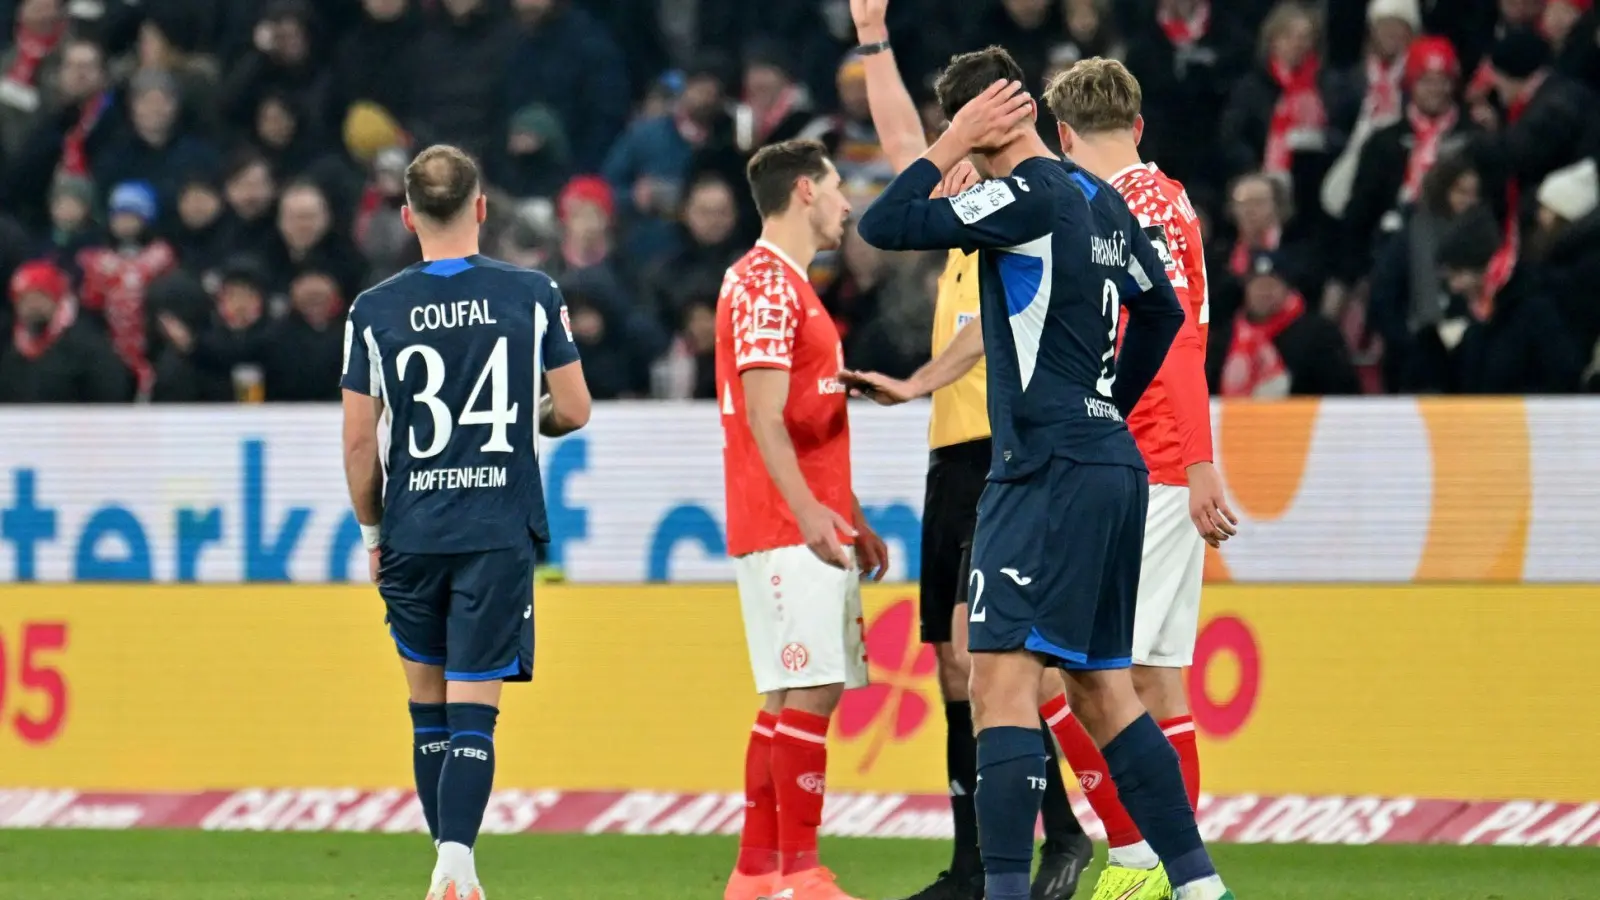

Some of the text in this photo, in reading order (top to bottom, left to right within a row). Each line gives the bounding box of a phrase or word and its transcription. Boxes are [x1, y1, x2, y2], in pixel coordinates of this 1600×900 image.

[1090, 230, 1126, 267] HRANÁČ
[410, 299, 497, 332] COUFAL
[1096, 278, 1119, 397] 2
[396, 336, 519, 459] 34
[408, 466, 507, 492] HOFFENHEIM
[969, 570, 986, 623] 2
[0, 621, 68, 743] 5
[420, 741, 450, 755] TSG
[452, 747, 488, 761] TSG
[1026, 776, 1047, 790] TS
[1238, 794, 1416, 845] DOGS
